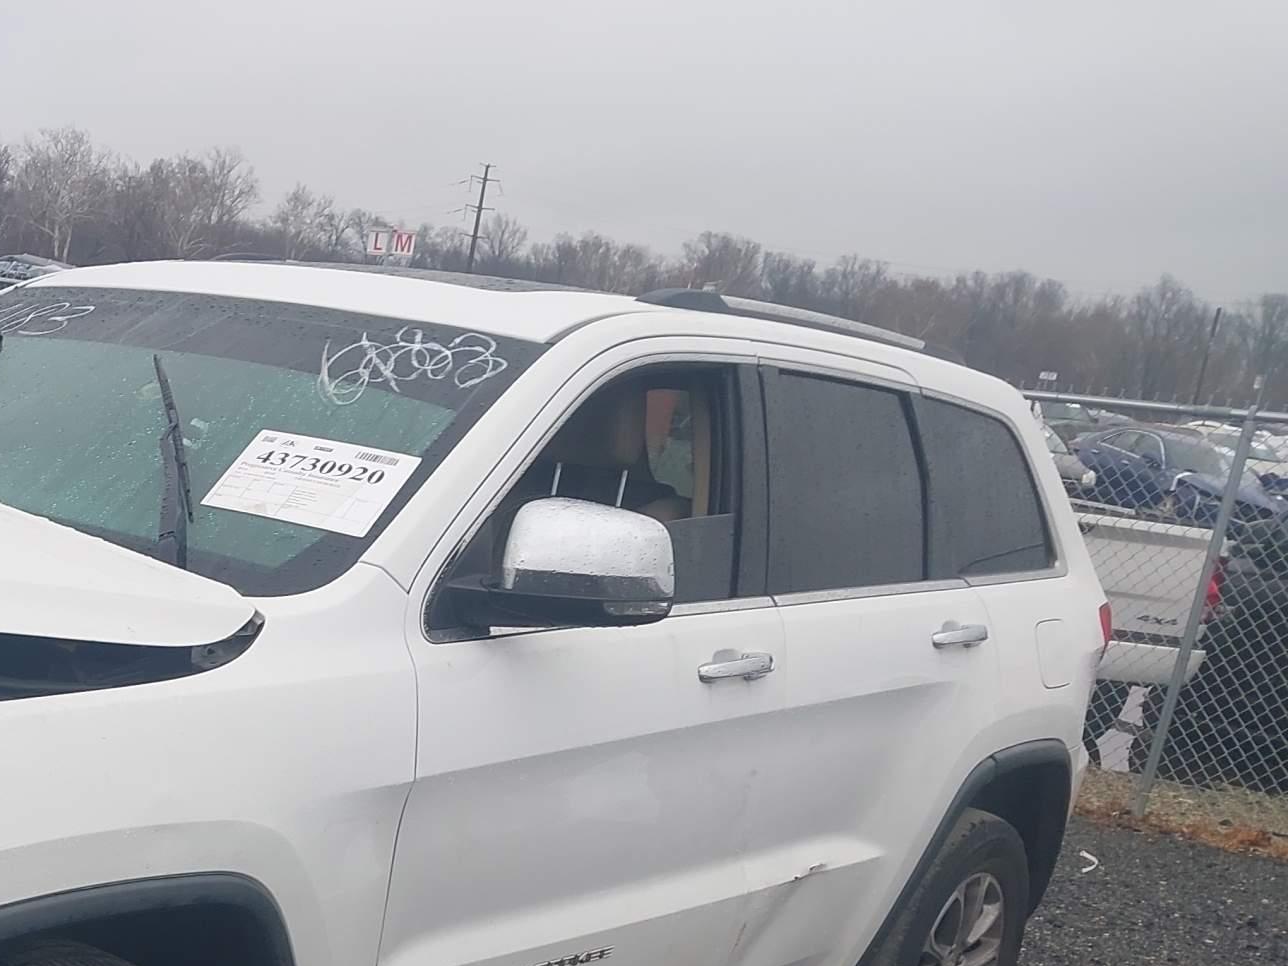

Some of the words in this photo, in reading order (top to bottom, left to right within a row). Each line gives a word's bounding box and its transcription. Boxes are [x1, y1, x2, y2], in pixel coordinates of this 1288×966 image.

[374, 232, 383, 250] L
[394, 234, 412, 253] M
[256, 450, 385, 485] 43730920
